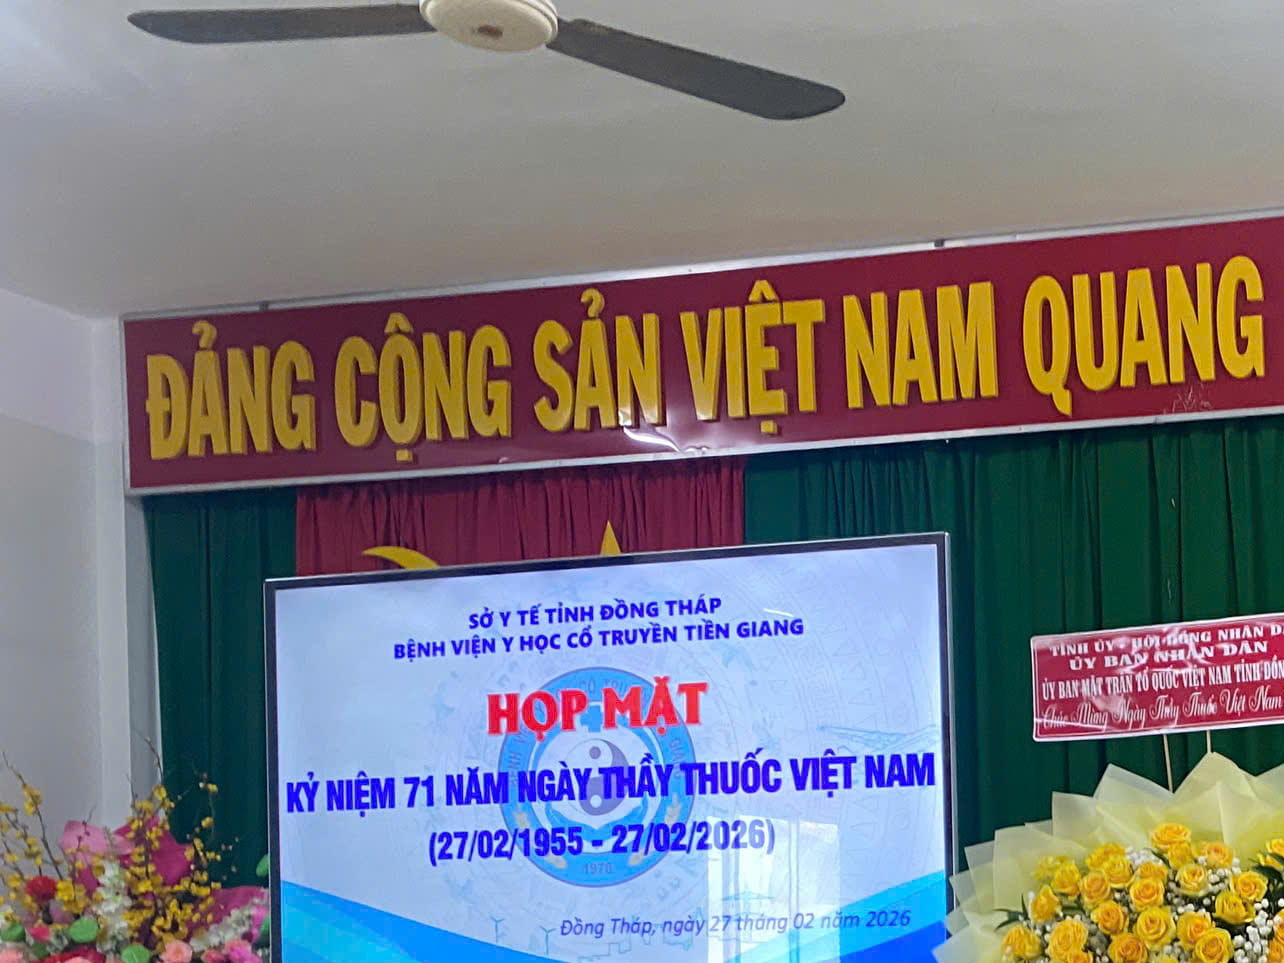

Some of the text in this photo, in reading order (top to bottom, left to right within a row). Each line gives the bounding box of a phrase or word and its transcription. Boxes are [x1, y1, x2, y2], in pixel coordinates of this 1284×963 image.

[145, 319, 315, 460] ĐẢNG
[334, 312, 512, 462] CỘNG
[533, 288, 663, 432] SẢN
[679, 279, 826, 434] VIỆT
[843, 281, 998, 409] NAM
[1023, 255, 1265, 417] QUANG
[468, 593, 722, 630] SỞ Y TẾ TỈNH ĐỒNG THÁP
[394, 618, 805, 663] BỆNH VIỆN Y HỌC CỔ TRUYỀN TIỀN GIANG
[1218, 624, 1264, 641] NHÂN
[1058, 679, 1079, 699] BAN
[1151, 663, 1179, 692] QUỐC
[1208, 660, 1233, 686] NAM
[1104, 652, 1148, 668] BAN
[487, 676, 709, 742] HỌP MẶT
[1249, 684, 1282, 713] Nam
[286, 747, 936, 818] KỶ NIỆM 71 NĂM NGÀY THẦY THUỐC VIỆT NAM
[429, 819, 775, 867] (27/02/1955 - 27/02/2026)
[560, 907, 912, 939] Đồng Tháp, ngày 27 tháng 02 năm 2026
